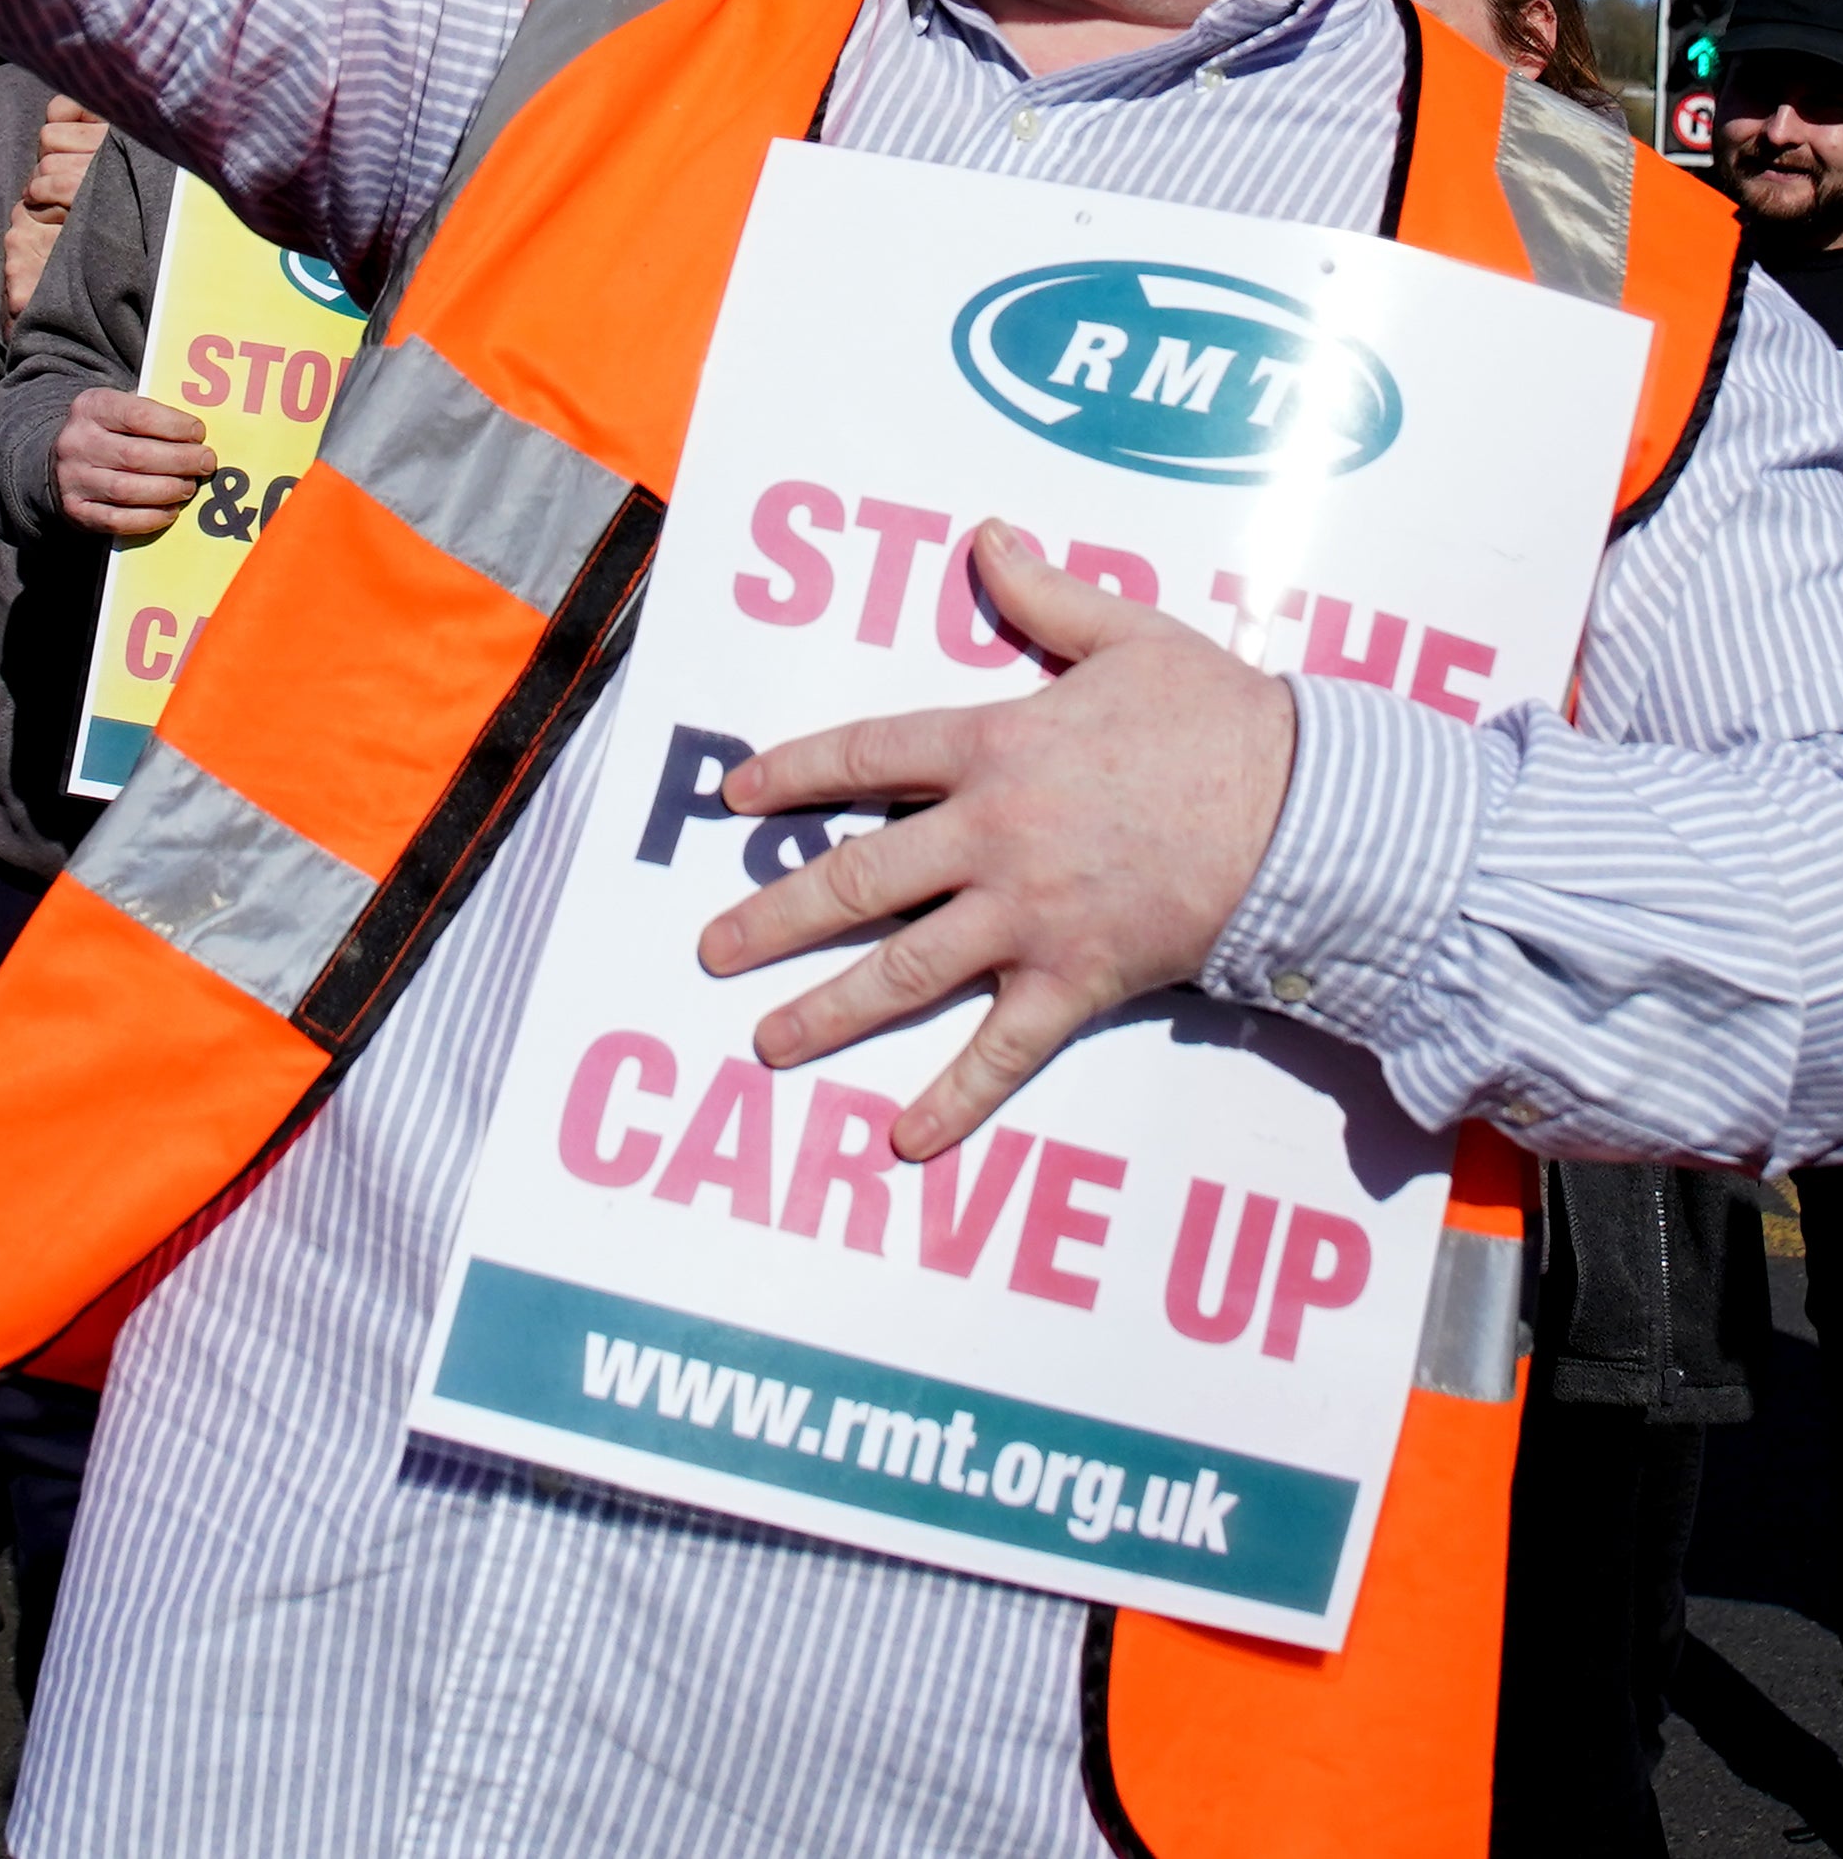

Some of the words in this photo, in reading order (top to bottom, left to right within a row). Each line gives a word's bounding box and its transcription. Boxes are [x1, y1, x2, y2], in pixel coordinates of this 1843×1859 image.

[1048, 318, 1323, 432] RMT
[557, 1028, 1130, 1313] CARVE
[1163, 1175, 1374, 1364] UP
[581, 1330, 1241, 1556] www.rmt.org.uk
